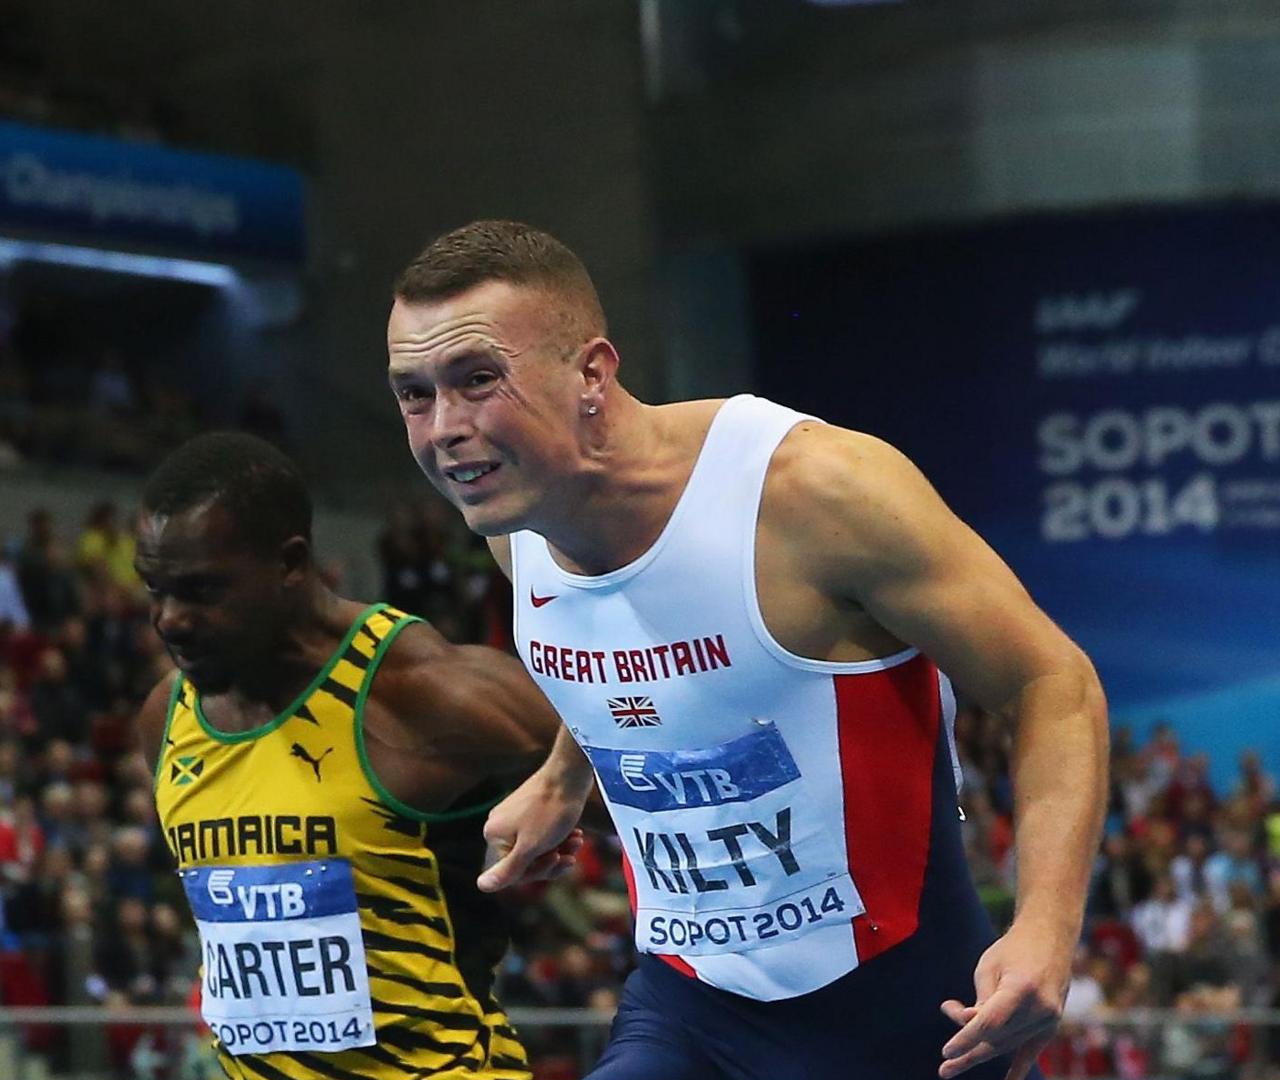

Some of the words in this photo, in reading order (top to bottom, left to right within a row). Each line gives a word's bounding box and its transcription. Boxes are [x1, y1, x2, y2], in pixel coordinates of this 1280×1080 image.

[1040, 473, 1219, 541] 2014
[530, 640, 608, 683] GREAT
[613, 634, 732, 683] BRITAIN
[654, 769, 739, 805] VTB
[633, 807, 800, 894] KILTY
[237, 882, 307, 920] VTB
[650, 916, 749, 946] SOPOT
[753, 887, 845, 940] 2014
[206, 935, 357, 999] CARTER
[294, 1017, 363, 1043] 2014
